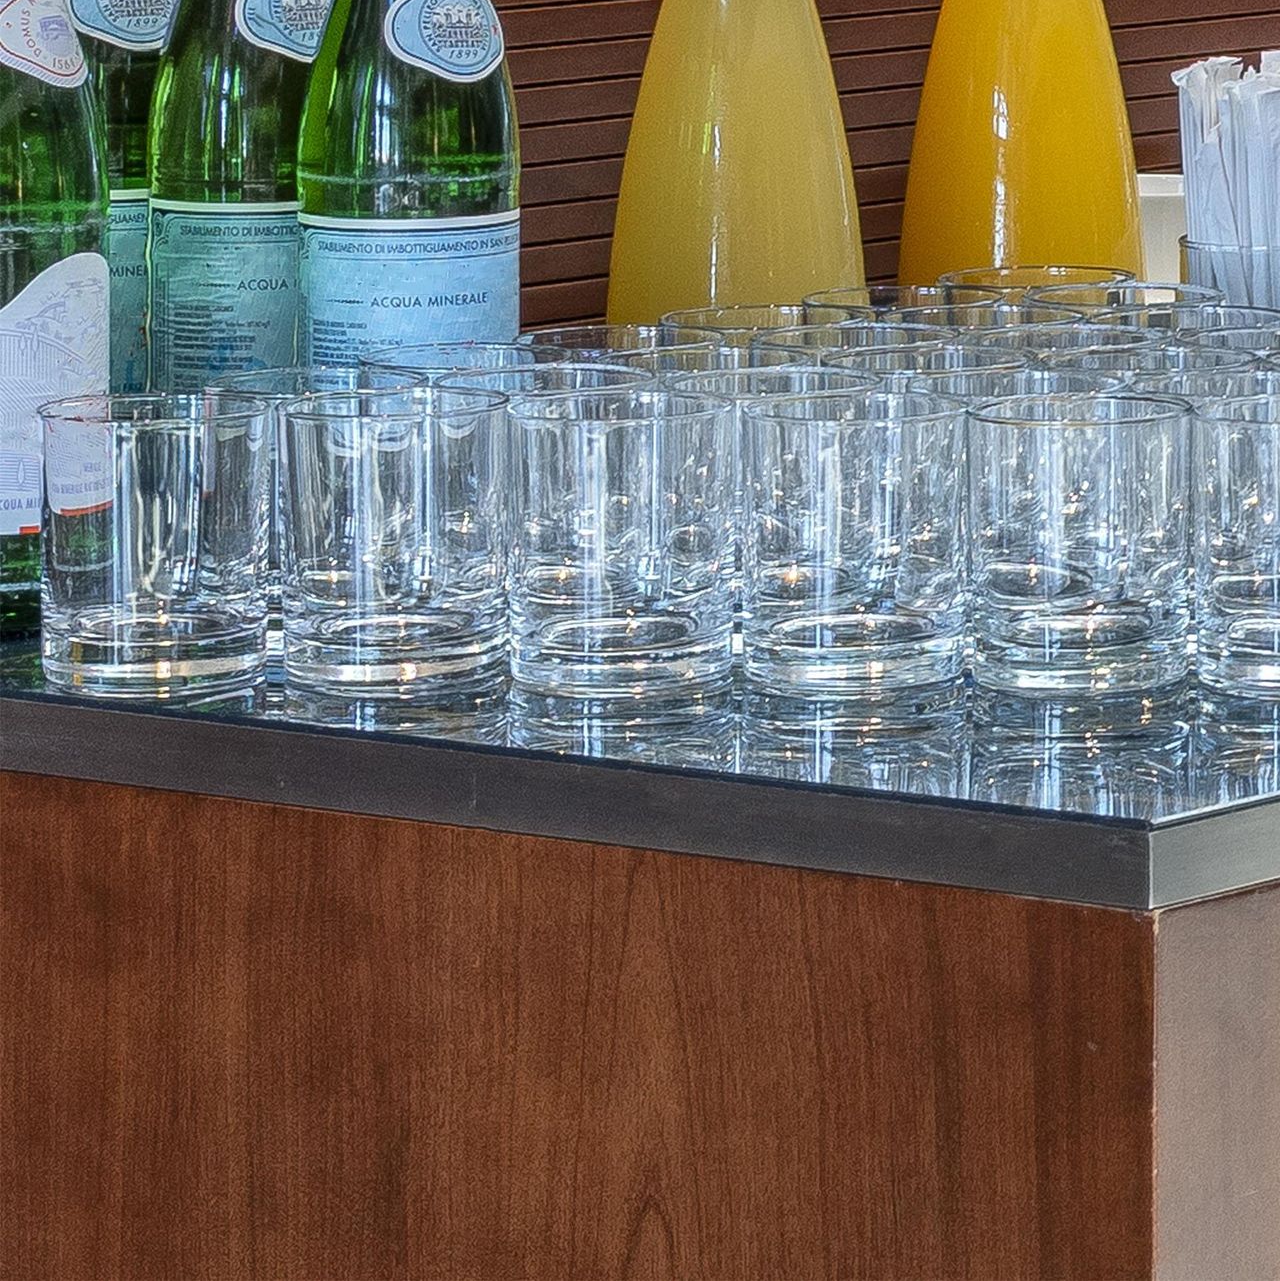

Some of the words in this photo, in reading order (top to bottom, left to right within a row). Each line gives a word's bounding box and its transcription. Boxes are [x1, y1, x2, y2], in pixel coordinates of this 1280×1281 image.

[127, 18, 159, 29] 1899
[21, 8, 42, 58] DOMUS
[449, 49, 479, 59] 1899
[375, 243, 385, 254] DI
[237, 279, 289, 291] ACQUA
[371, 296, 422, 308] ACQUA
[427, 291, 488, 308] MINERALE
